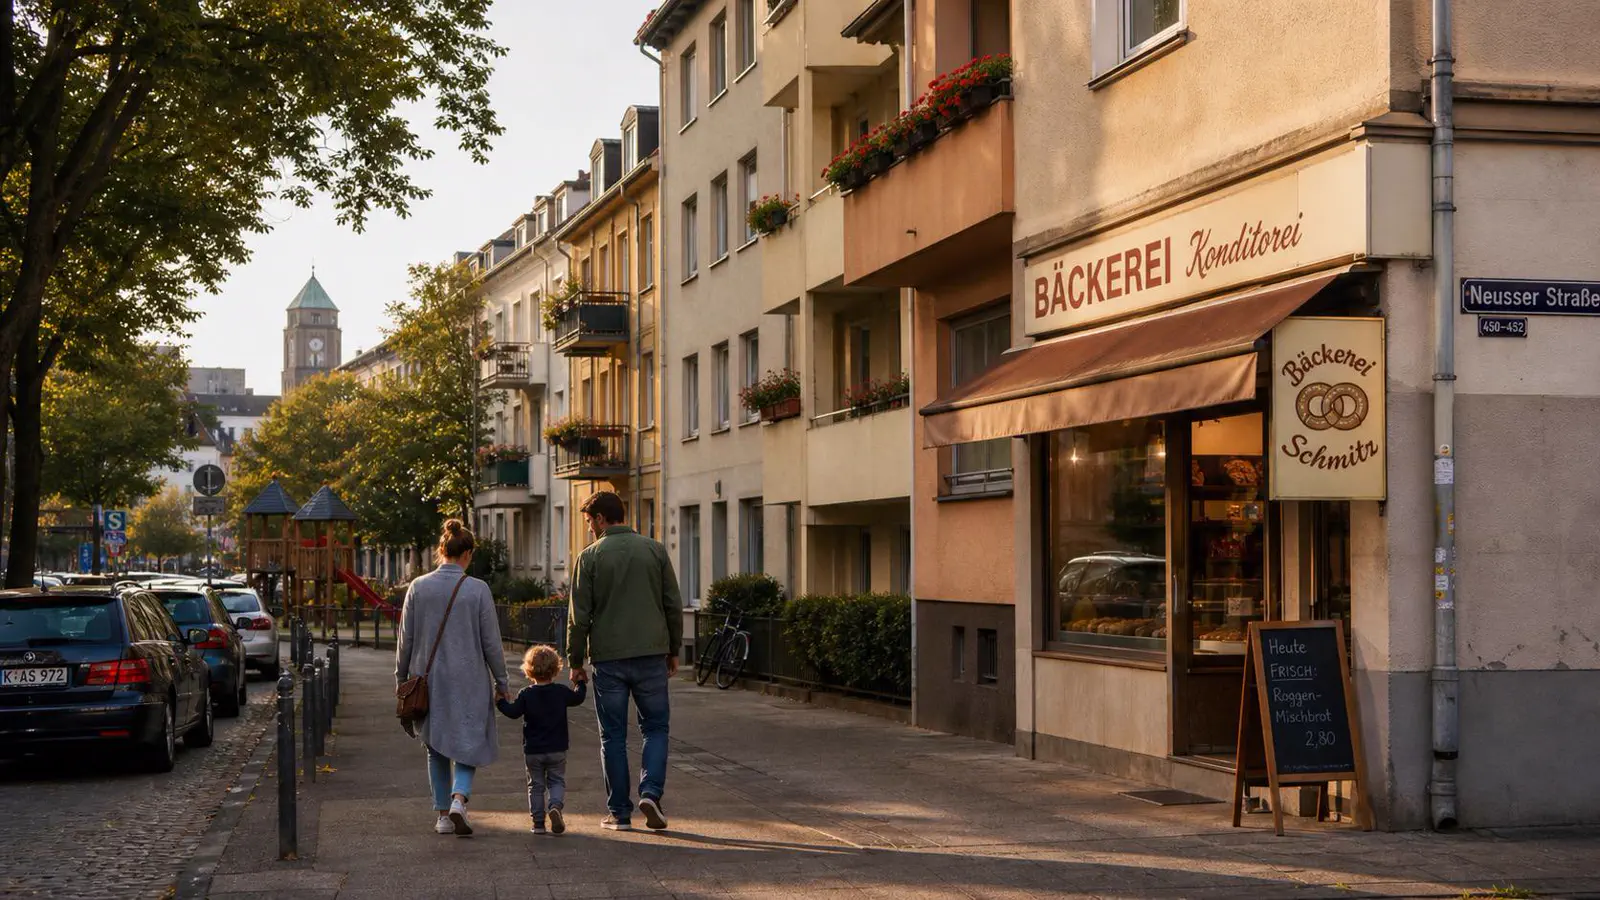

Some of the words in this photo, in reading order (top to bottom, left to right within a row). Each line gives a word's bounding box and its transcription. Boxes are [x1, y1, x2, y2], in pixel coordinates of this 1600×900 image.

[1034, 236, 1171, 319] BÄCKEREI
[1186, 212, 1303, 279] Konditorei
[1470, 285, 1539, 306] Neusser
[1546, 287, 1600, 307] Straße
[1483, 321, 1524, 333] 450-452
[108, 512, 122, 530] S
[1268, 638, 1308, 655] Heute
[4, 671, 12, 683] K
[19, 669, 36, 682] AS
[40, 668, 64, 682] 972
[1270, 662, 1318, 678] FRISCH:
[1273, 687, 1322, 708] Roggen-
[1275, 708, 1333, 724] Mischbrot
[1305, 730, 1336, 749] 2,80
